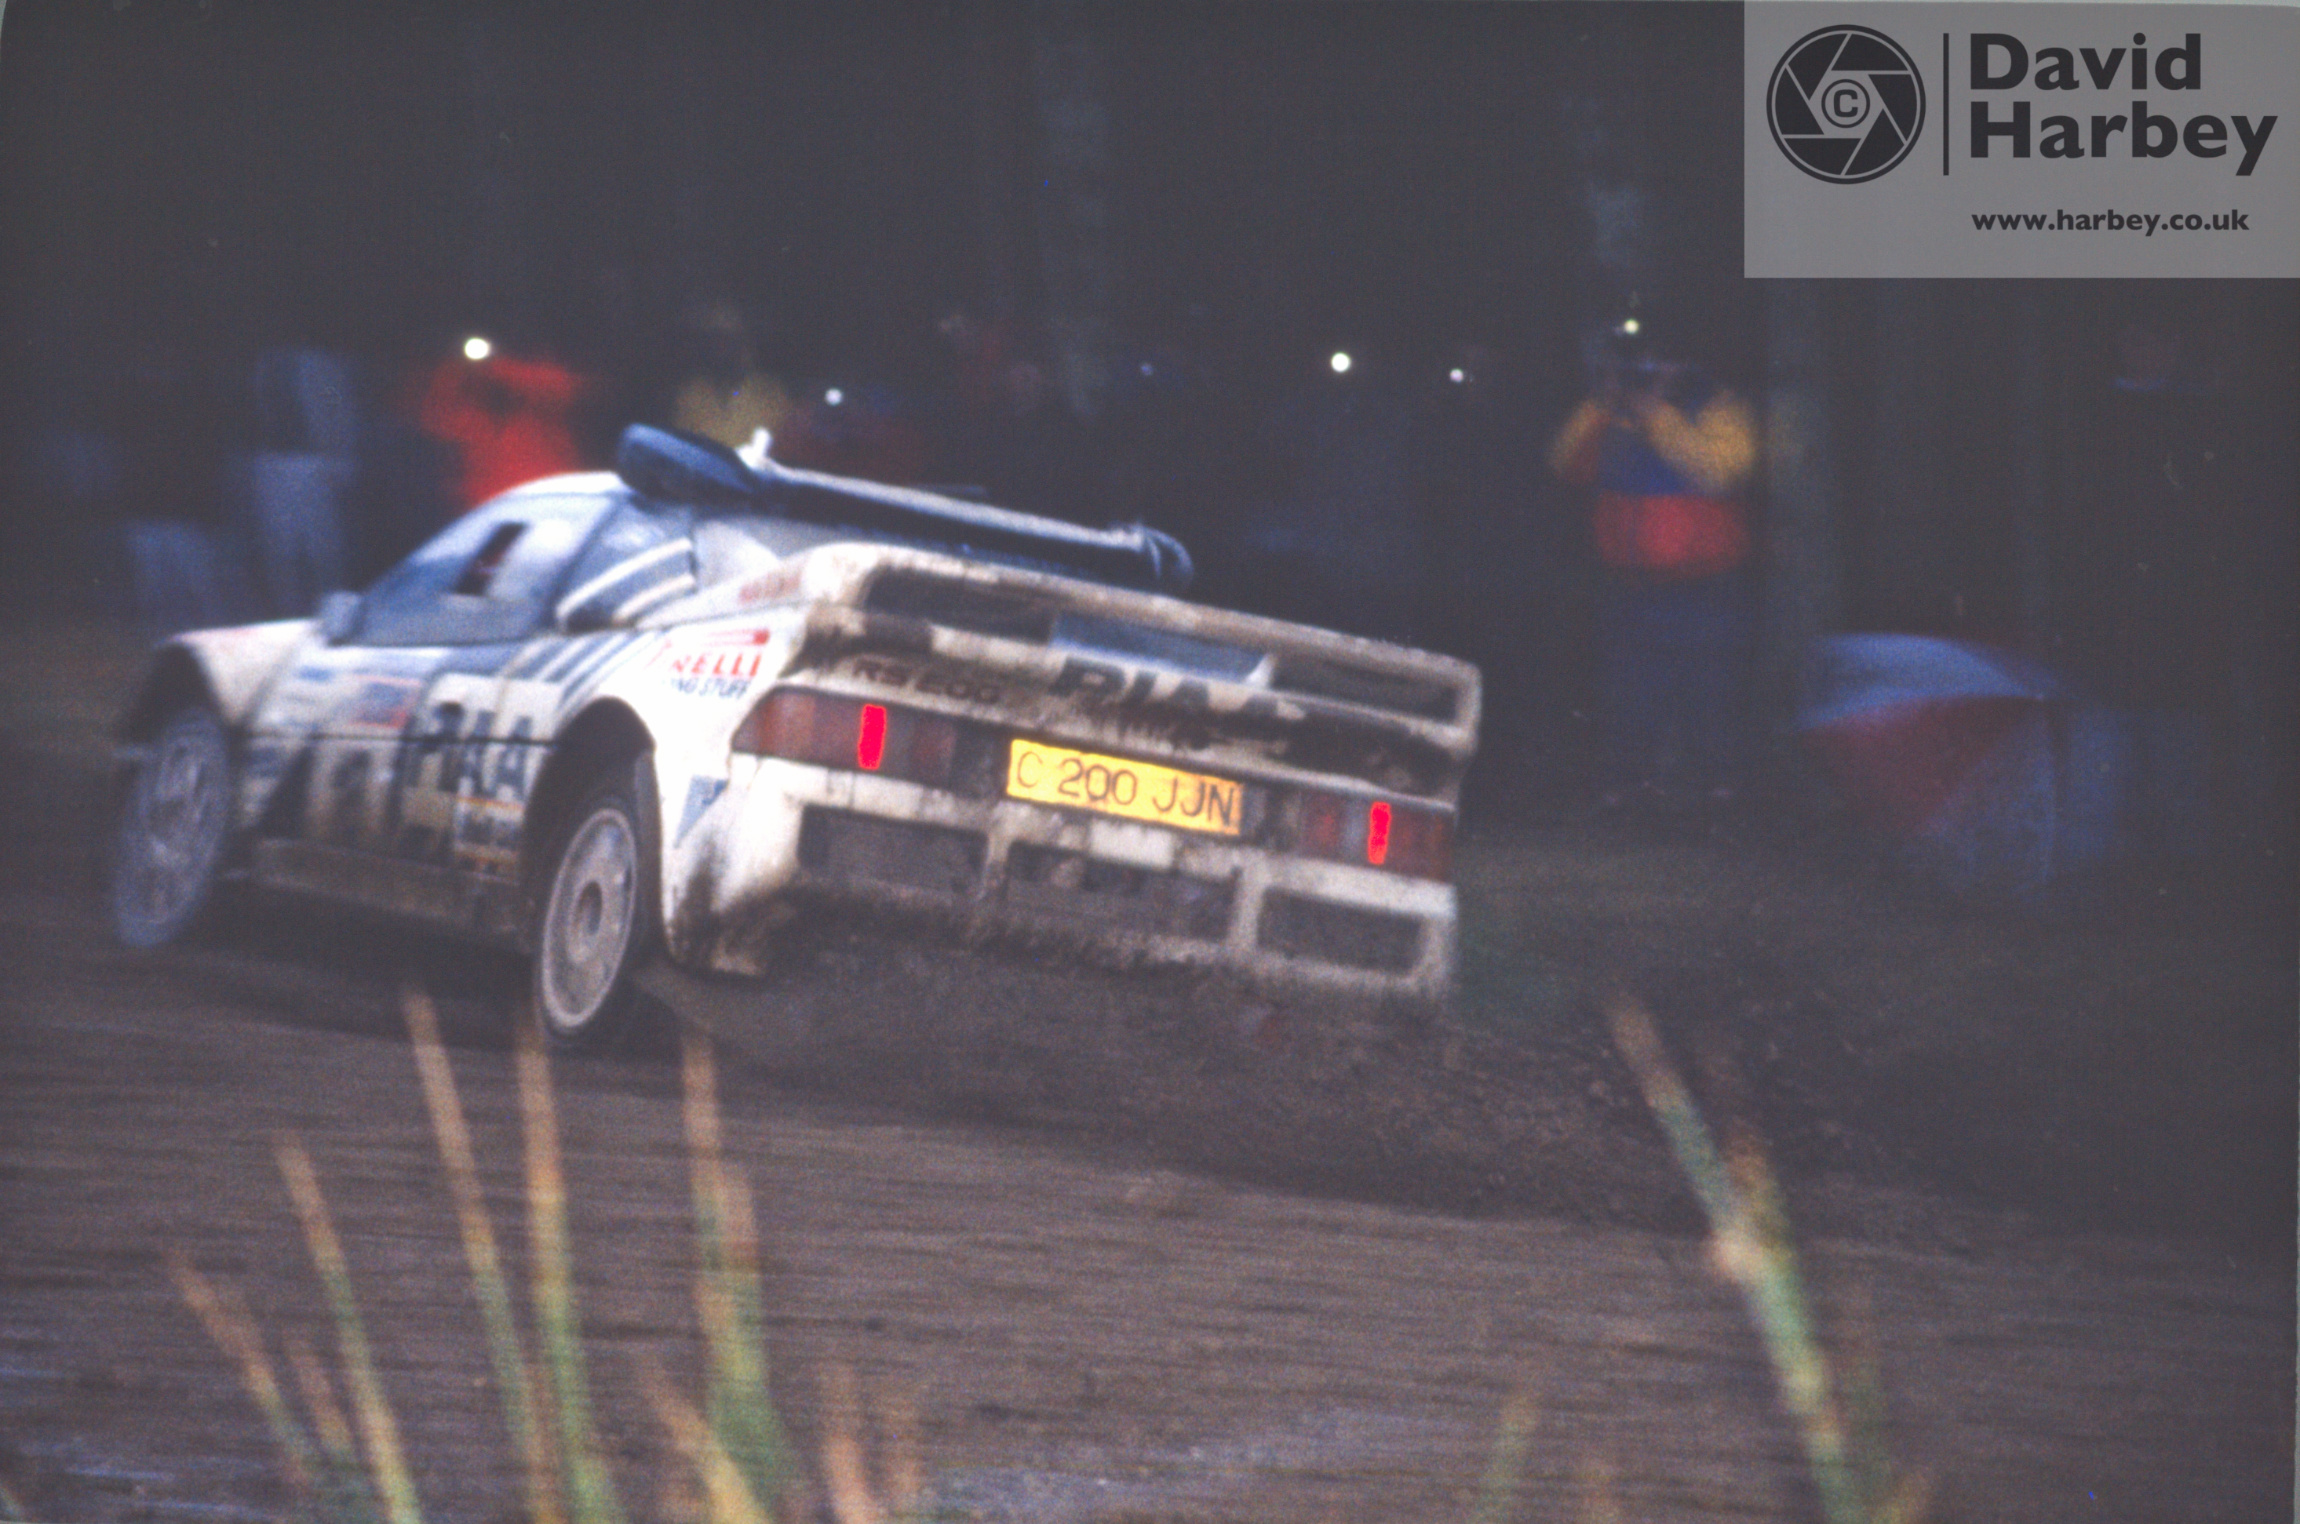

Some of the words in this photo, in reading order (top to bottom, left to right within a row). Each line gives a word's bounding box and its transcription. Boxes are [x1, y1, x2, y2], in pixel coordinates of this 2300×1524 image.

[1018, 751, 1043, 788] C
[1058, 758, 1138, 806] 200
[1153, 777, 1236, 827] JJN
